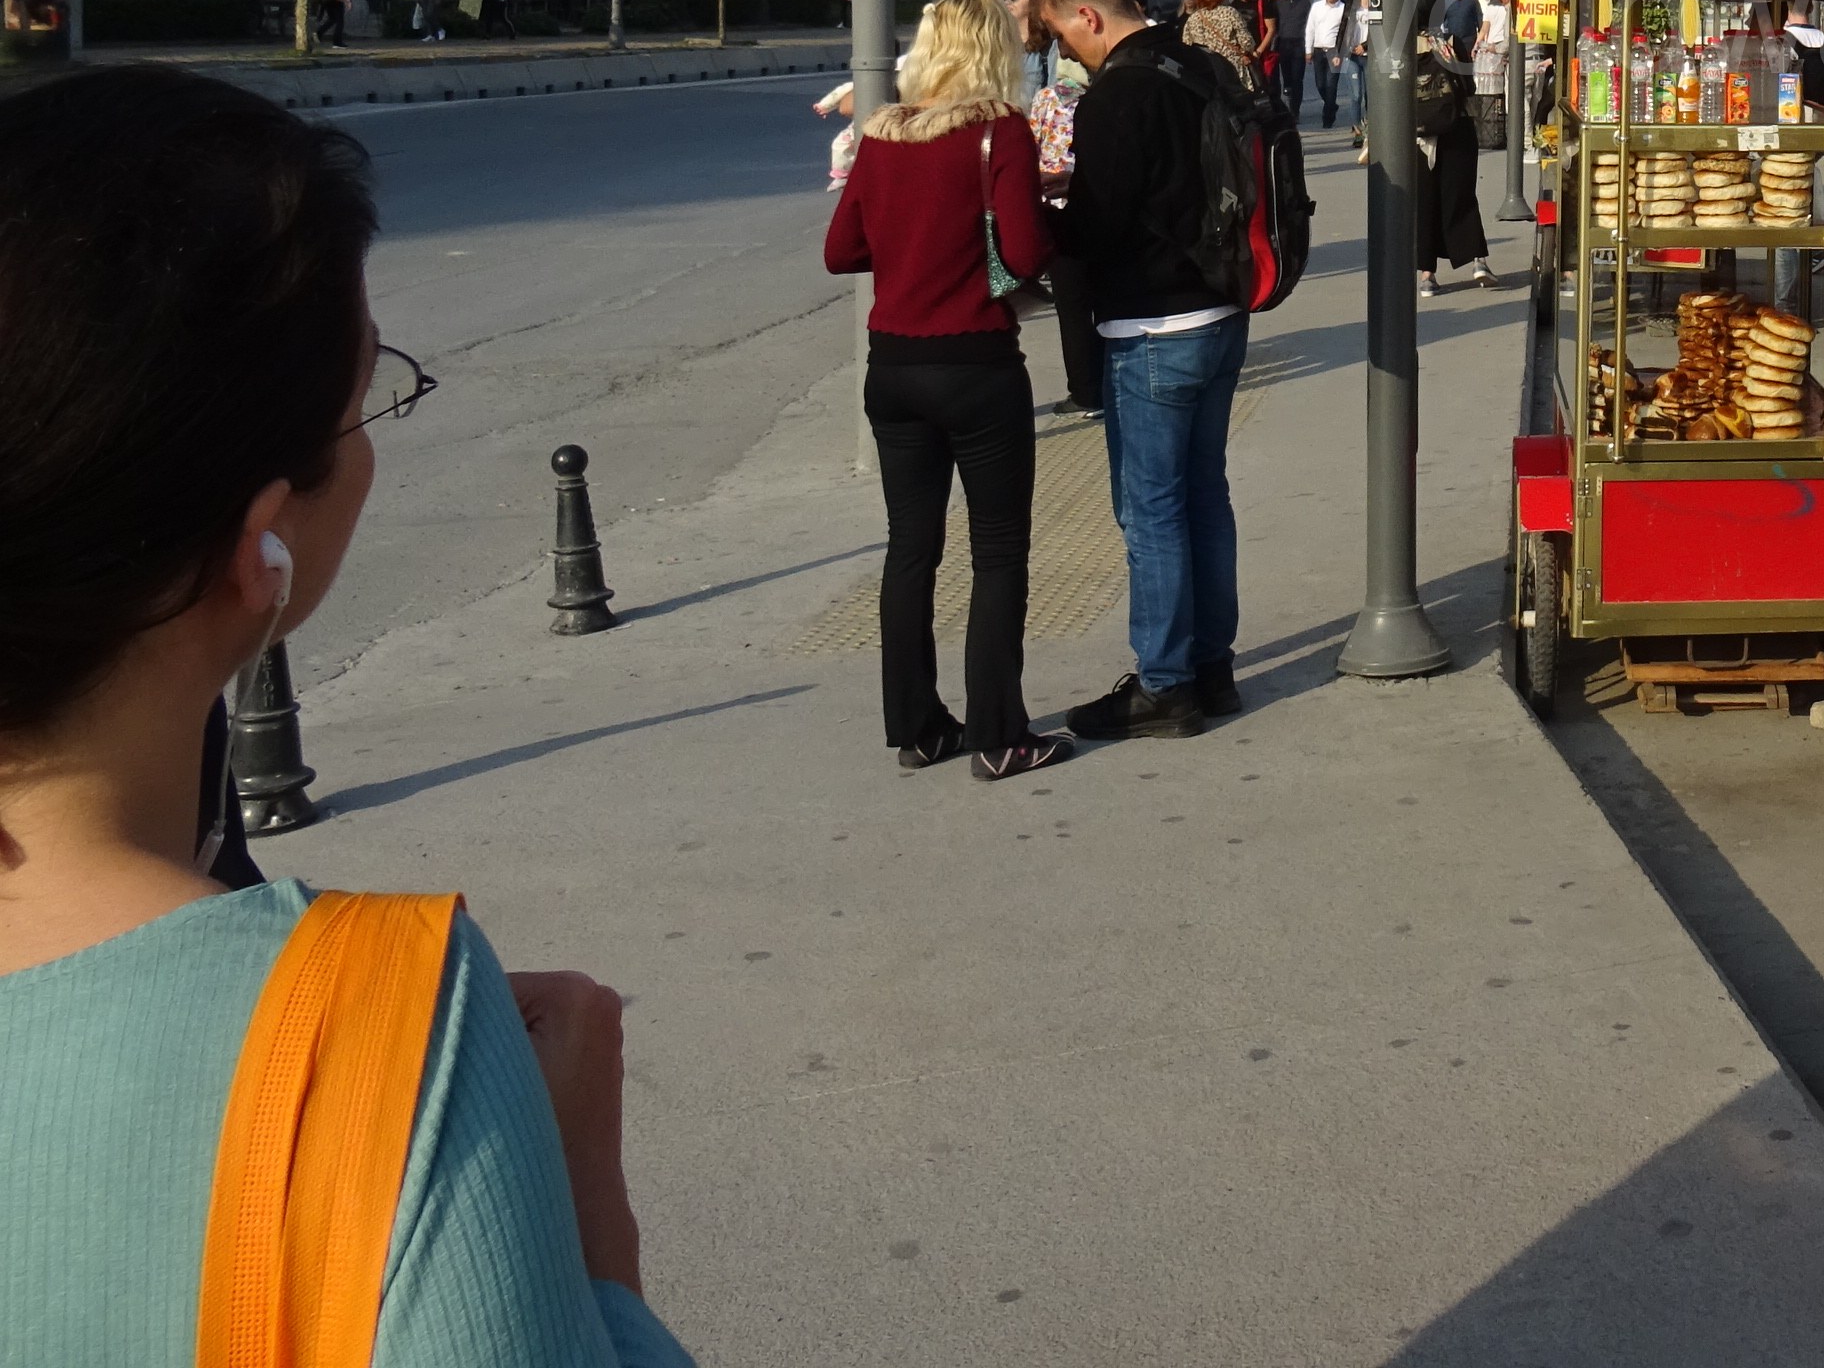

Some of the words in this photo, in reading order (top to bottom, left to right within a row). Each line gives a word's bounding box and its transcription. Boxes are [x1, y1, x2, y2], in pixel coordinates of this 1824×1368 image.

[1520, 3, 1558, 16] MISIR
[1521, 18, 1537, 40] 4
[1540, 33, 1552, 41] TL
